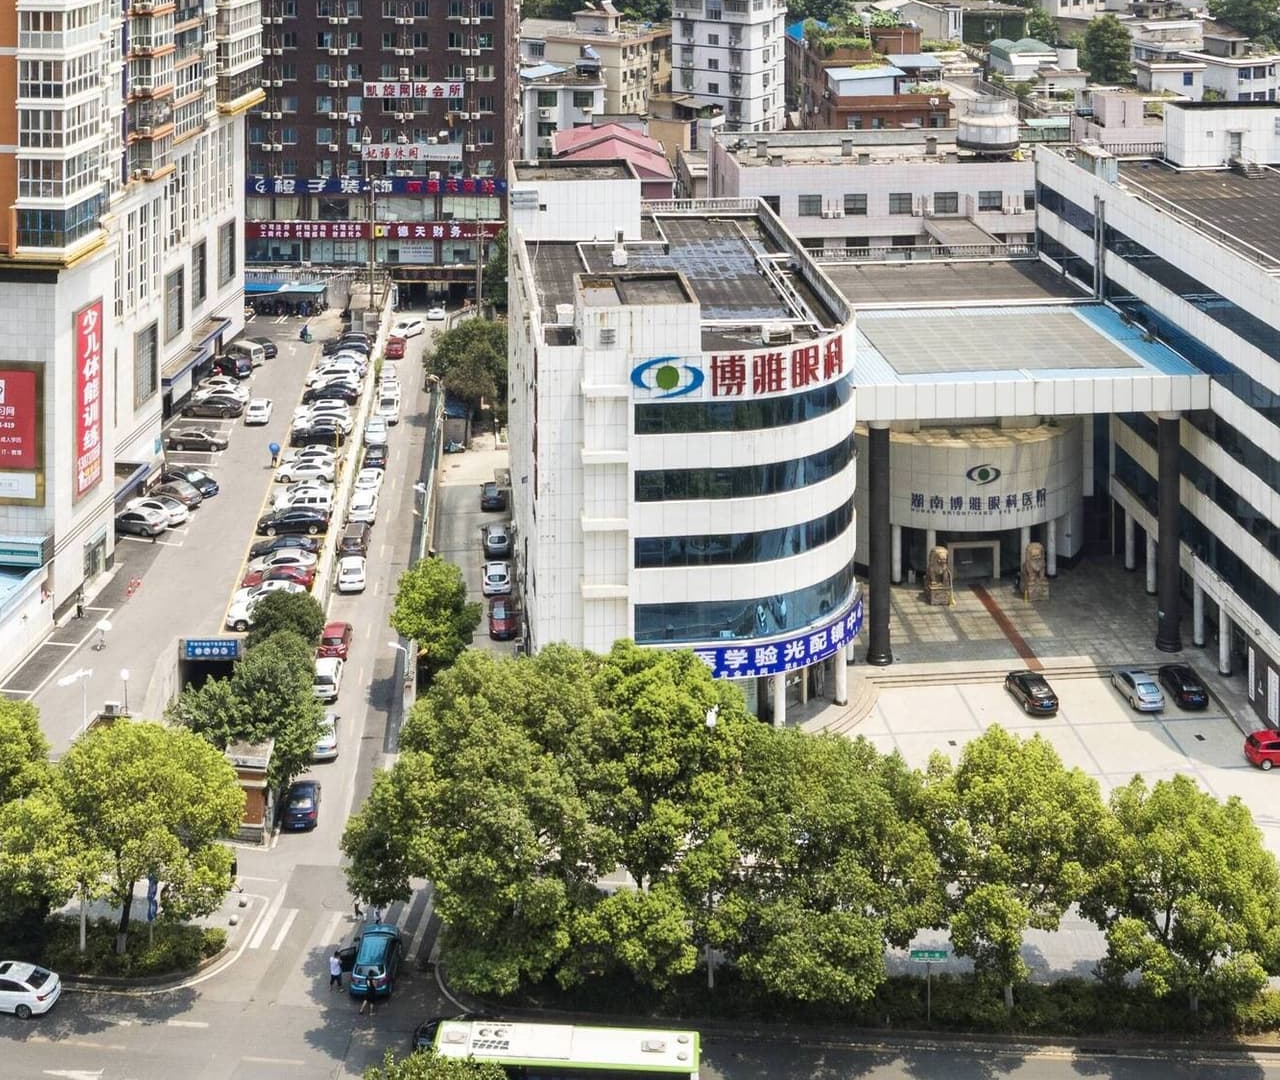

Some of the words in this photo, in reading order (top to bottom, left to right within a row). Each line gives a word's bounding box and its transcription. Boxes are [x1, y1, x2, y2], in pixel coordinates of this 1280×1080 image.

[366, 84, 460, 96] 凯旋网络会所
[275, 178, 393, 194] 橙子装饰
[398, 225, 462, 238] 德天财务
[710, 333, 844, 396] 博雅眼科
[82, 310, 100, 451] 少儿体能训练
[911, 487, 1047, 511] 湖南博雅眼科医院
